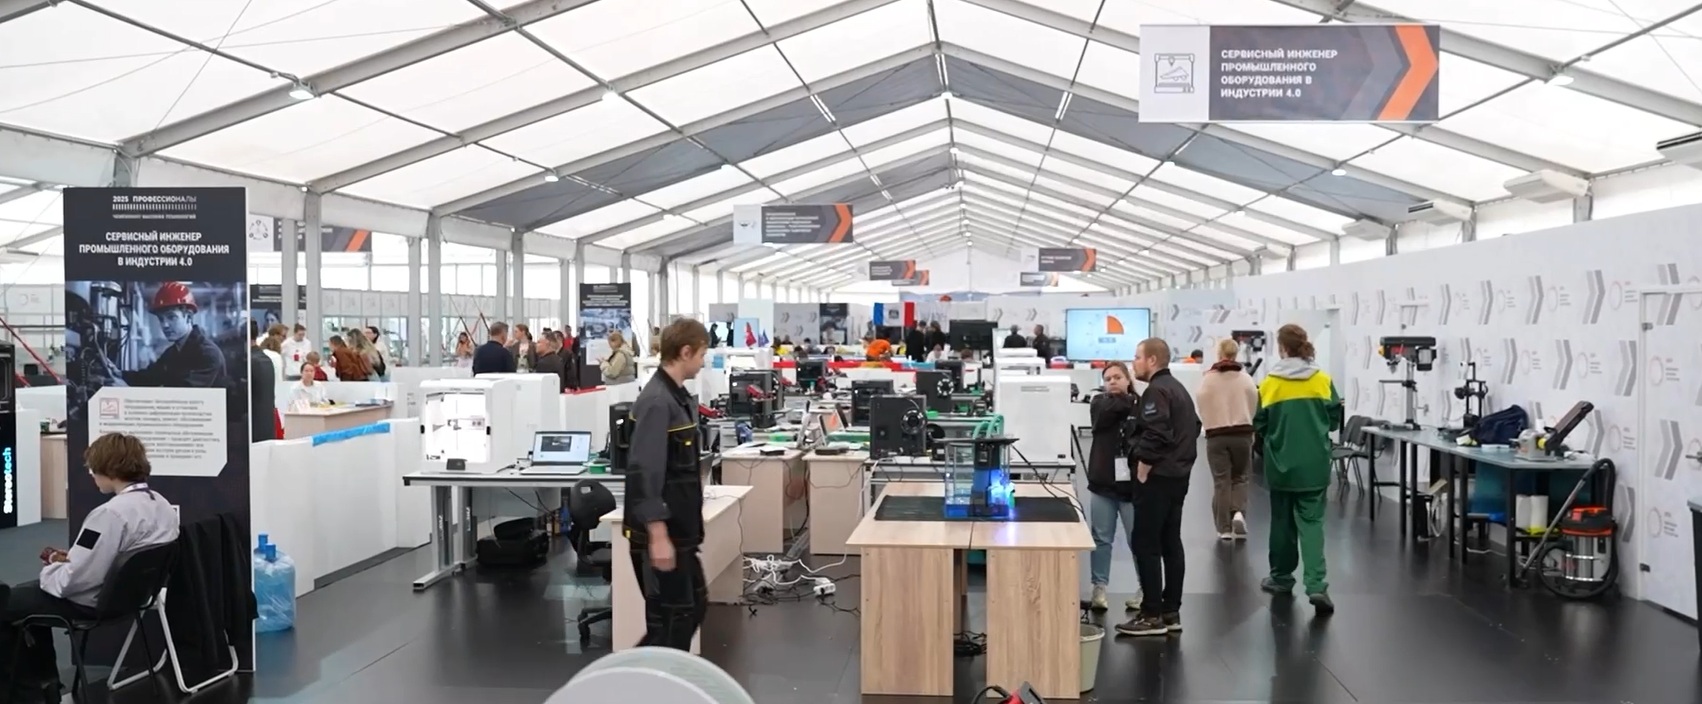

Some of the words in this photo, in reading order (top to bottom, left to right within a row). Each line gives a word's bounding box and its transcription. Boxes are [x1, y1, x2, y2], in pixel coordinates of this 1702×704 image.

[1221, 48, 1284, 58] СЕРВИСНЫЙ
[1287, 49, 1338, 58] ИНЖЕНЕР
[1221, 62, 1316, 71] ПРОМЫШЛЕННОГО
[1221, 75, 1303, 86] ОБОРУДОВАНИЯ
[1305, 76, 1312, 85] В
[1221, 88, 1283, 98] ИНДУСТРИИ
[1286, 89, 1302, 98] 4.0
[113, 195, 129, 203] 2025
[132, 195, 197, 203] ПРОФЕССИОНАЛЫ
[105, 231, 158, 241] СЕРВИСНЫЙ
[159, 232, 202, 241] ИНЖЕНЕР
[79, 244, 158, 254] ПРОМЫШЛЕННОГО
[160, 244, 230, 255] ОБОРУДОВАНИЯ
[117, 257, 124, 266] В
[125, 257, 178, 267] ИНДУСТРИИ
[179, 257, 193, 266] 4.0
